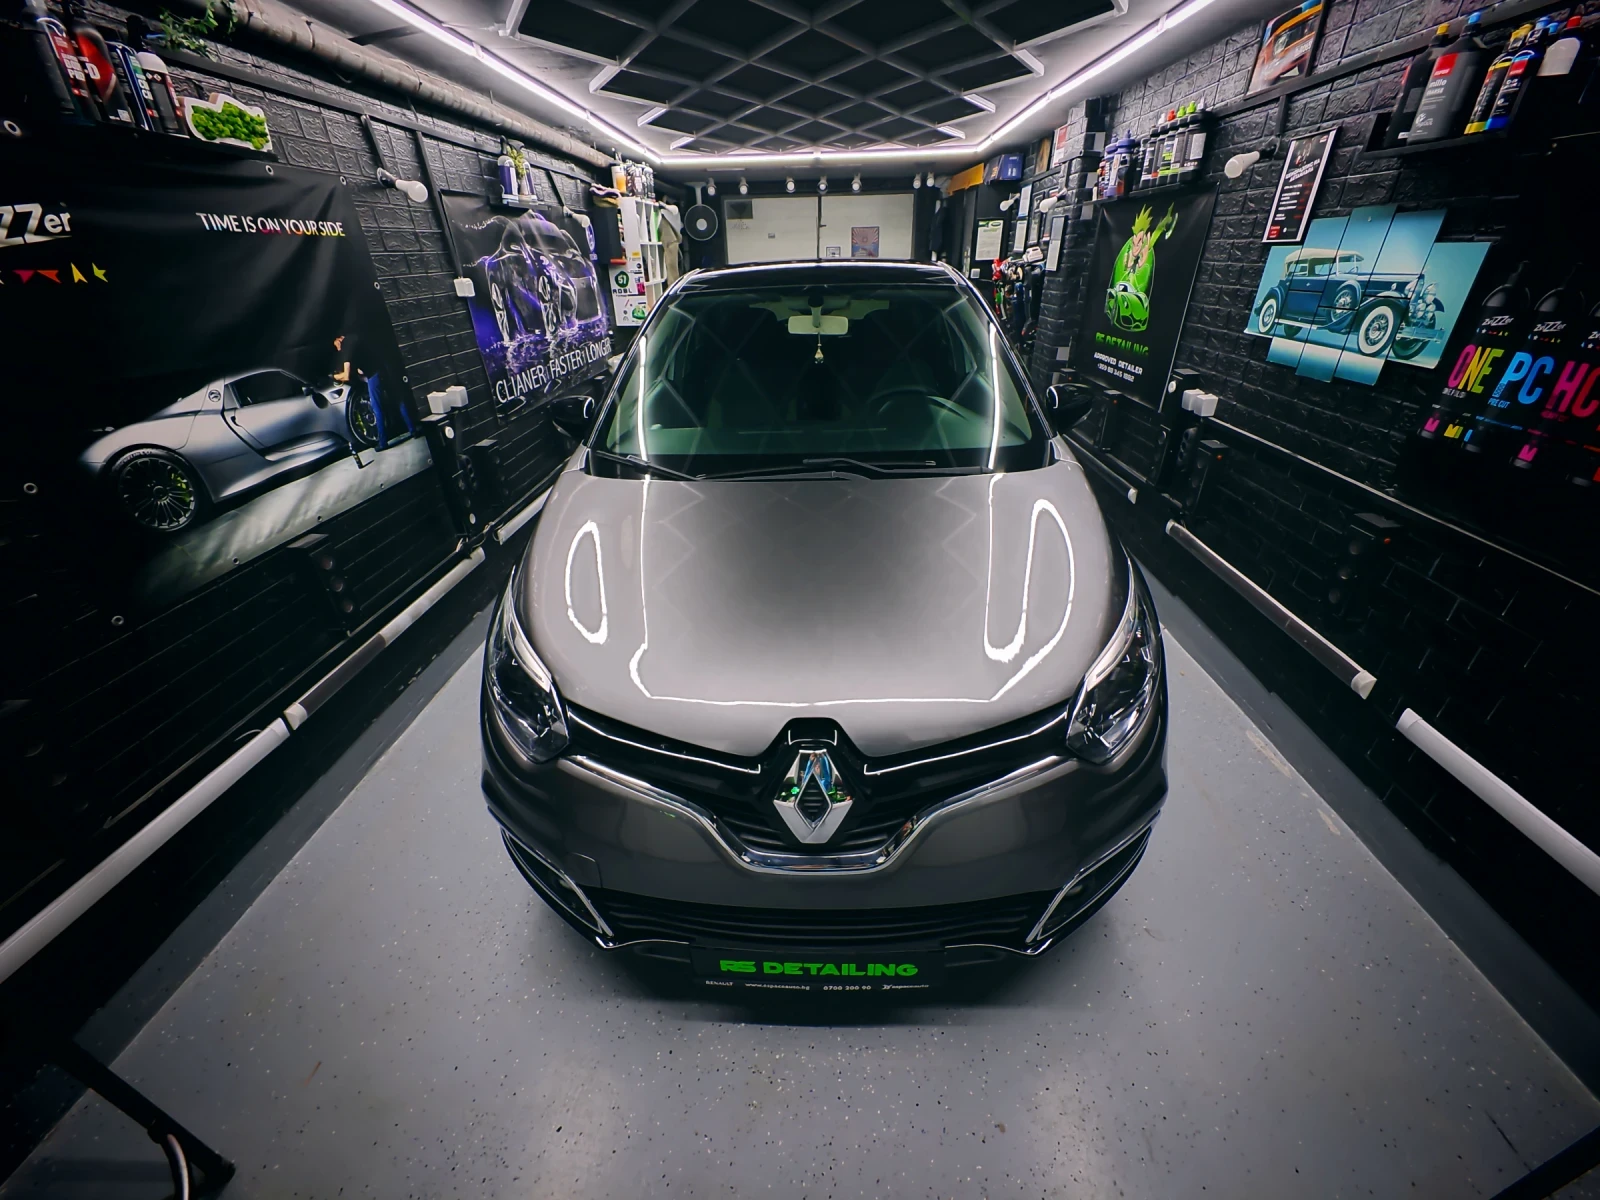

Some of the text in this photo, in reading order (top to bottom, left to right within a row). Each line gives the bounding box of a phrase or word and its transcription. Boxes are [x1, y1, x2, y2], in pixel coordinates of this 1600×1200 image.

[195, 212, 346, 237] TIME IS ON YOUR SIDE
[585, 337, 612, 363] LONGER
[1118, 361, 1143, 375] DETAILER
[1447, 344, 1505, 394] ONE
[1492, 351, 1555, 405] PC
[1545, 360, 1600, 418] HC
[719, 959, 919, 977] RS DETAILING
